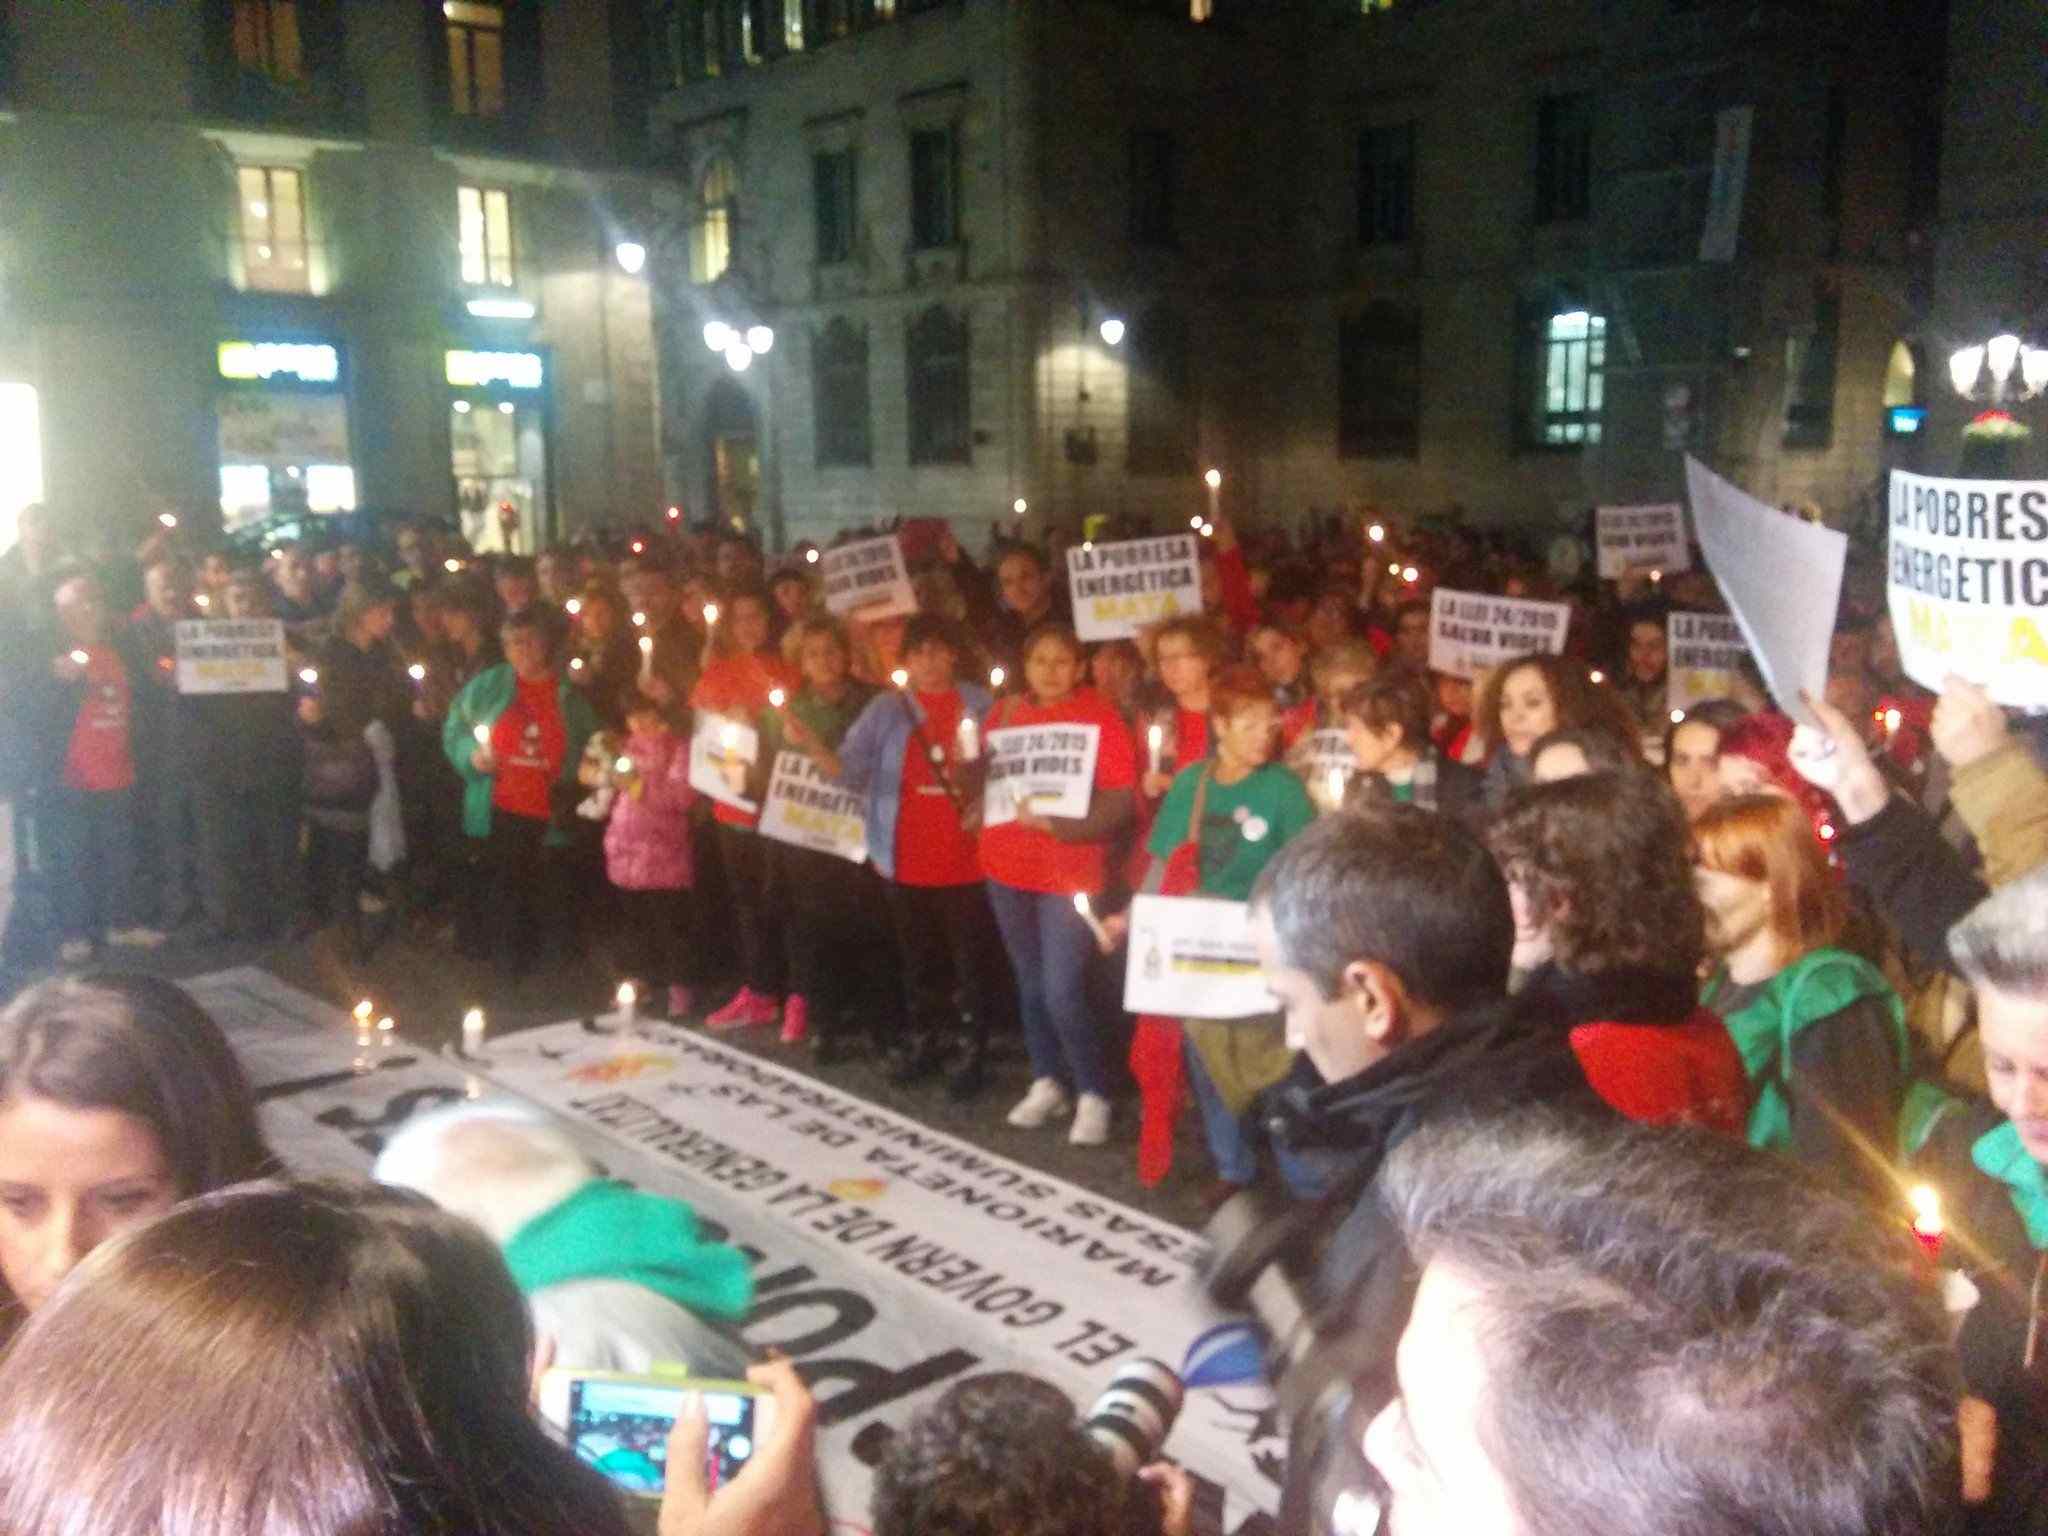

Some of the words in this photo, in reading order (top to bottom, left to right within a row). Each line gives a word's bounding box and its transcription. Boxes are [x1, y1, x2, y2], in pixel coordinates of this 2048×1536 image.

[1914, 484, 2048, 541] POBRES
[1073, 549, 1095, 572] LA
[1100, 540, 1191, 568] POBRESA
[1894, 541, 2048, 608] ENERGÈTIC
[1093, 592, 1178, 620] MATA
[1499, 632, 1554, 655] VIDES
[1030, 755, 1084, 775] VIDES
[708, 1085, 792, 1118] LAS
[796, 1119, 858, 1149] DE
[809, 1206, 896, 1244] DE
[863, 1146, 1177, 1287] MARIONETA
[869, 1234, 1066, 1328] GOVERN
[1055, 1318, 1138, 1367] EL
